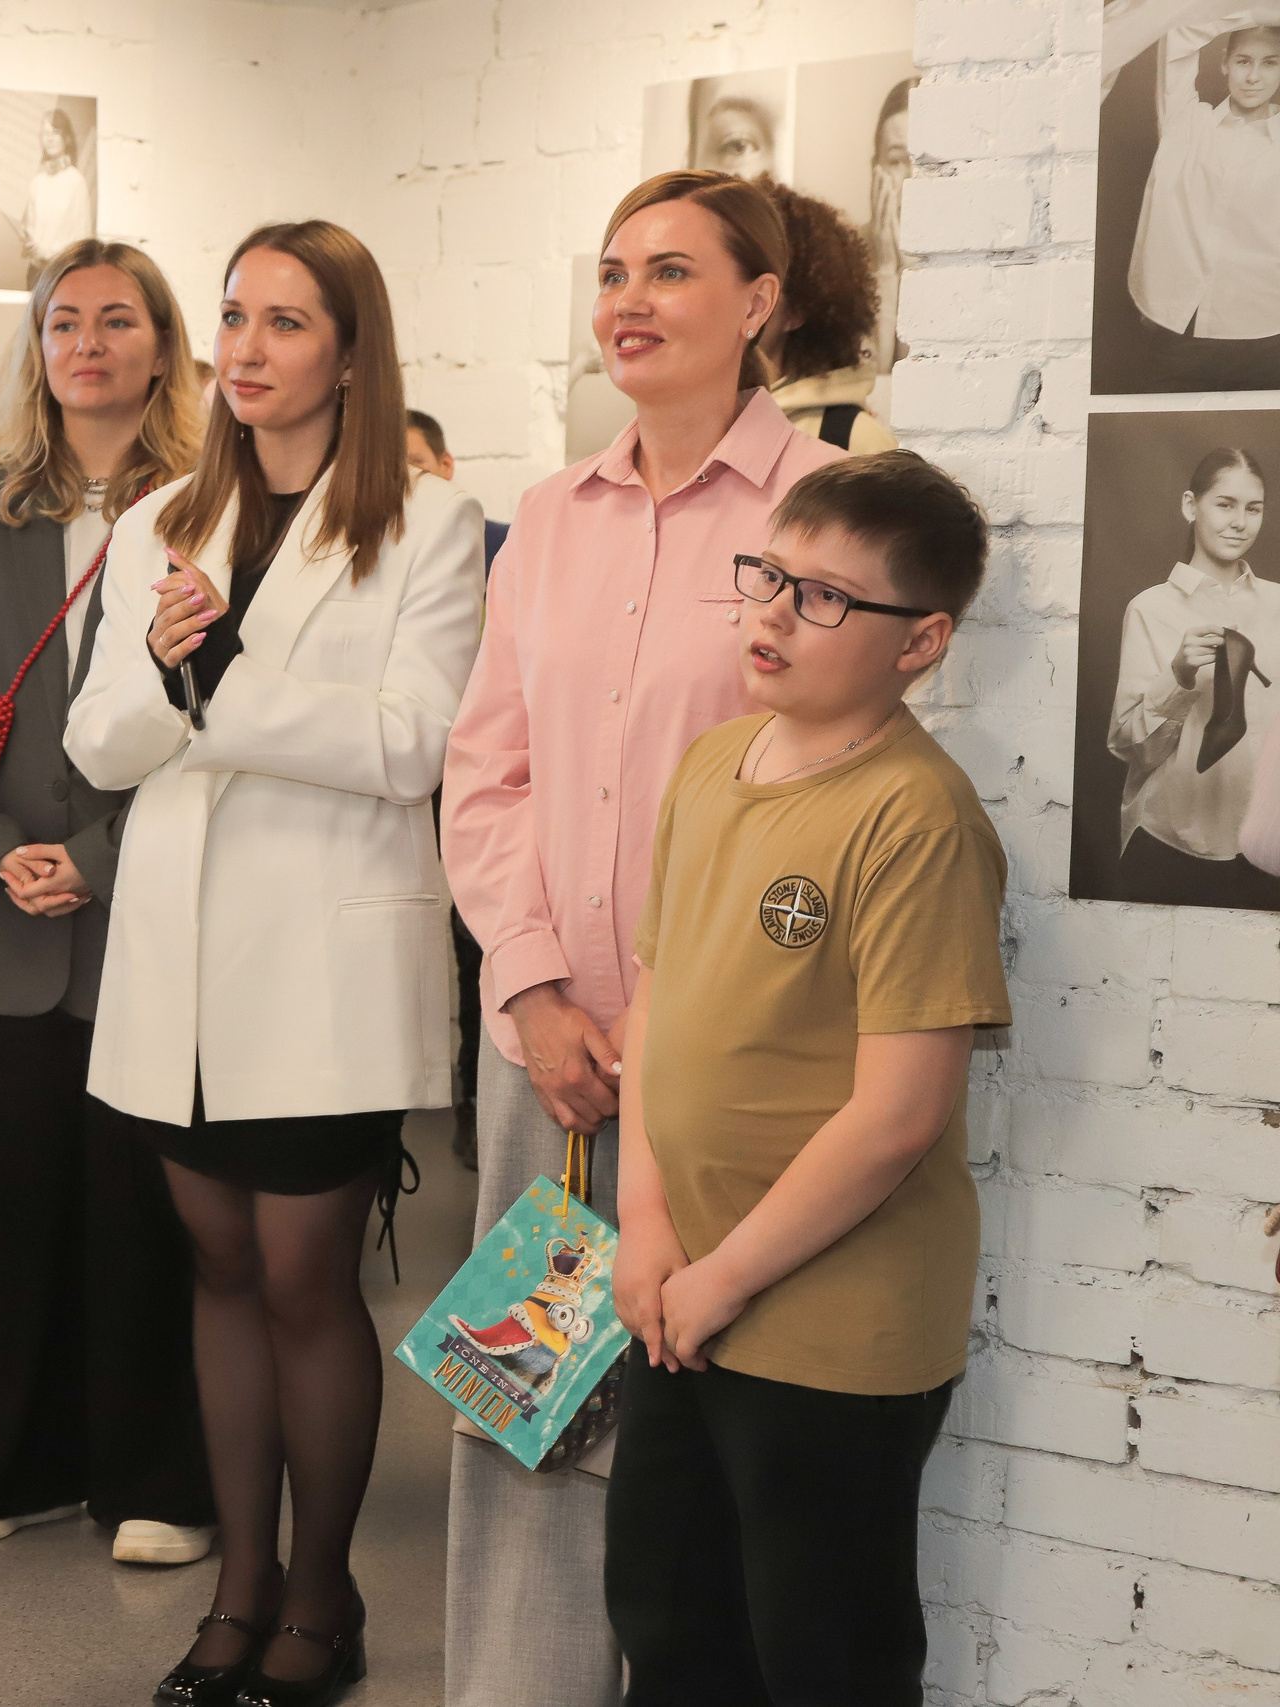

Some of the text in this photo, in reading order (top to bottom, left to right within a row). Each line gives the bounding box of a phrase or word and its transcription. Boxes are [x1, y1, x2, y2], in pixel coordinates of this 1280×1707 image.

[768, 882, 824, 917] STONE ISLAND
[764, 908, 821, 942] STONE ISLAND
[433, 1354, 519, 1433] MINION
[461, 1349, 520, 1401] ONE IN A
